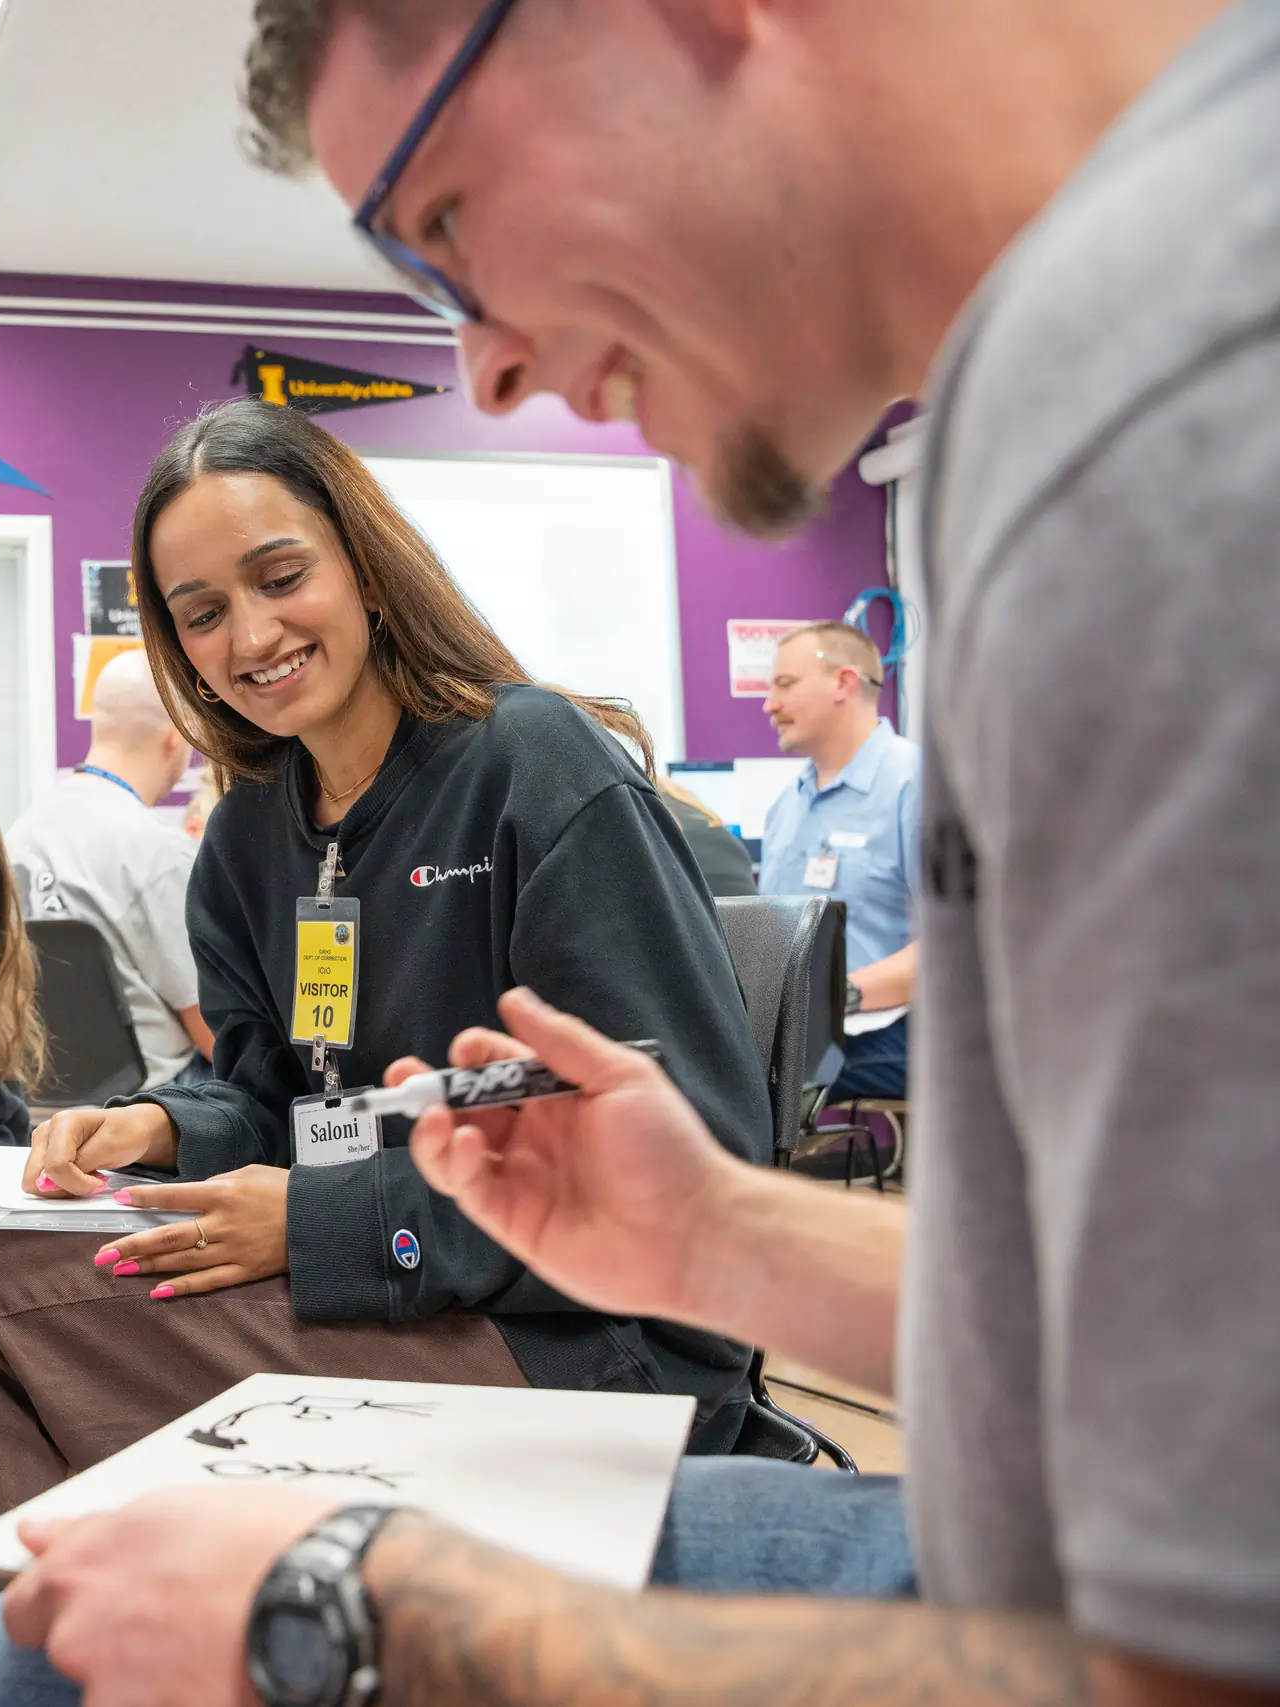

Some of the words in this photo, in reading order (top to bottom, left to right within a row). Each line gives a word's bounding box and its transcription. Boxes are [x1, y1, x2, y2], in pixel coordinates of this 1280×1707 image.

[410, 856, 494, 888] Champi
[300, 982, 349, 998] VISITOR
[312, 1004, 334, 1028] 10
[449, 1062, 526, 1103] EXPO
[310, 1117, 360, 1144] Saloni
[347, 1144, 371, 1154] She/her
